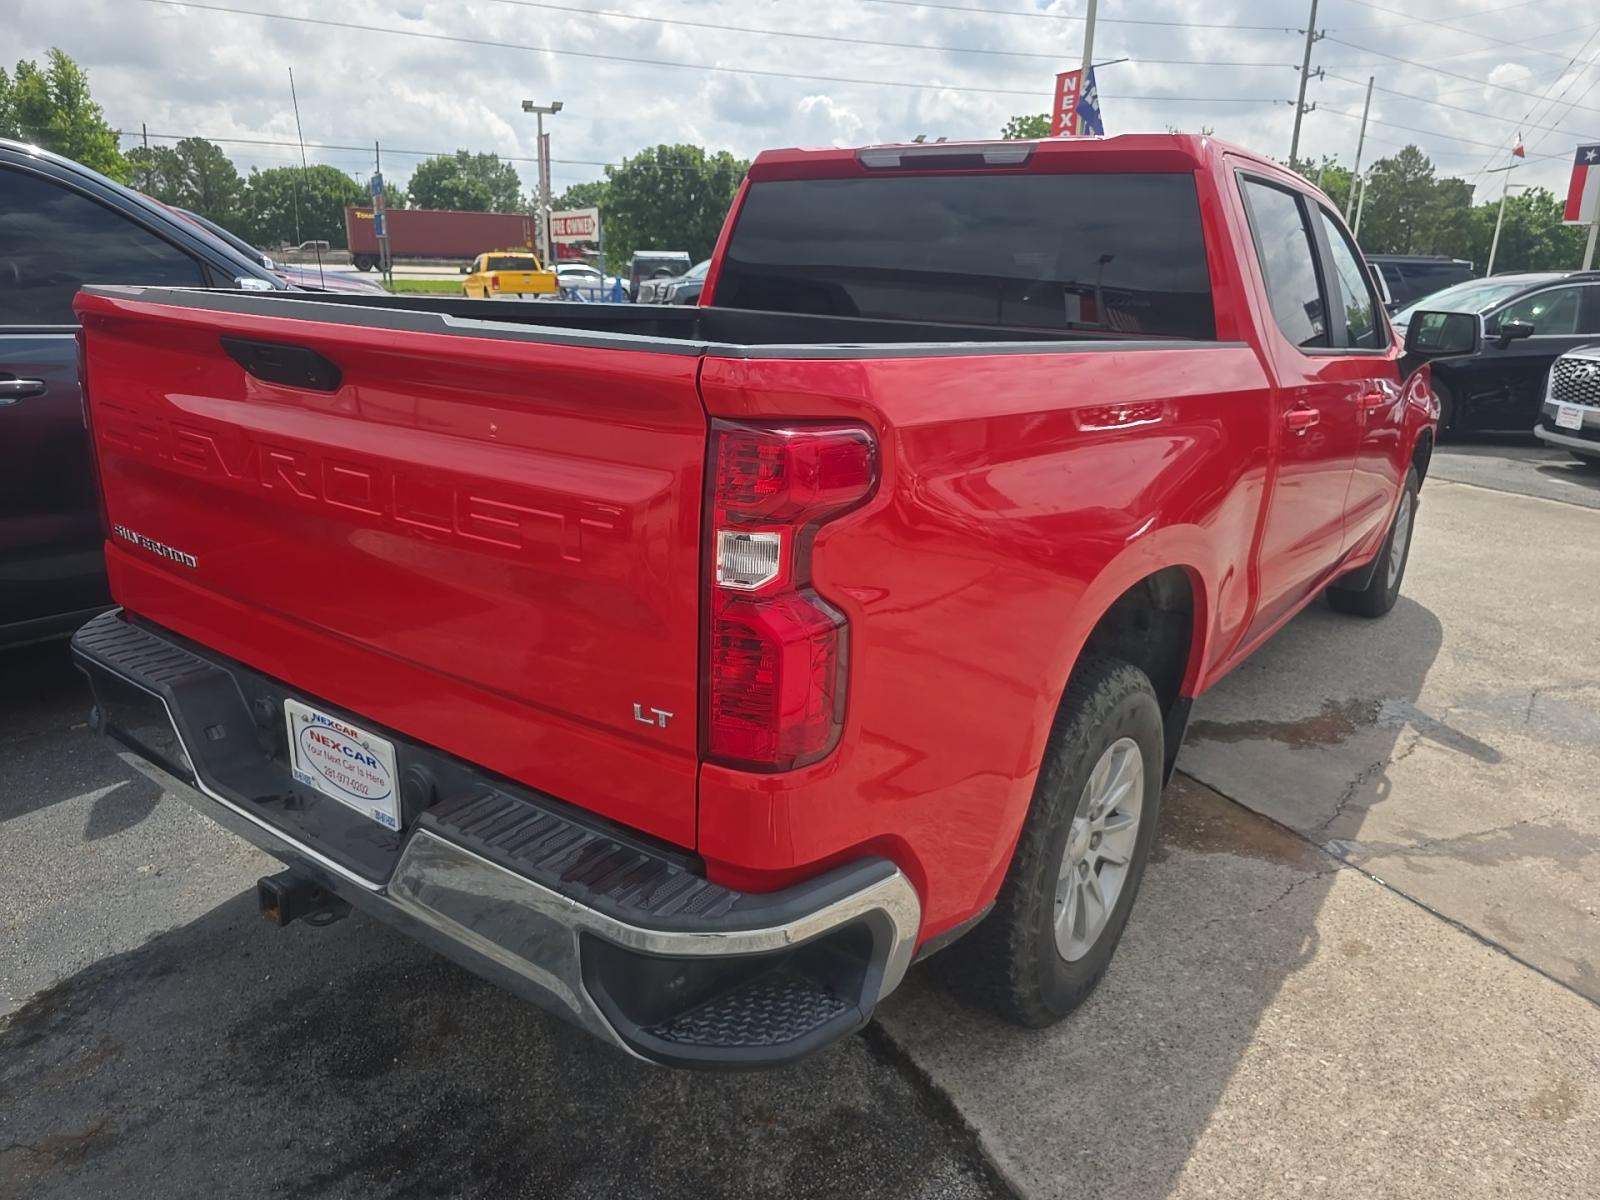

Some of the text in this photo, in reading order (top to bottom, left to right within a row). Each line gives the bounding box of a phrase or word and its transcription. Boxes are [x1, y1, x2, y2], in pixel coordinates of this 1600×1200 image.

[114, 524, 198, 569] SILVERADO
[311, 713, 359, 739] NEXCAR
[633, 703, 674, 728] LT
[306, 741, 325, 757] Your
[324, 749, 341, 766] Next
[342, 758, 356, 772] Car
[365, 769, 385, 787] Here
[309, 729, 377, 770] NEXCAR
